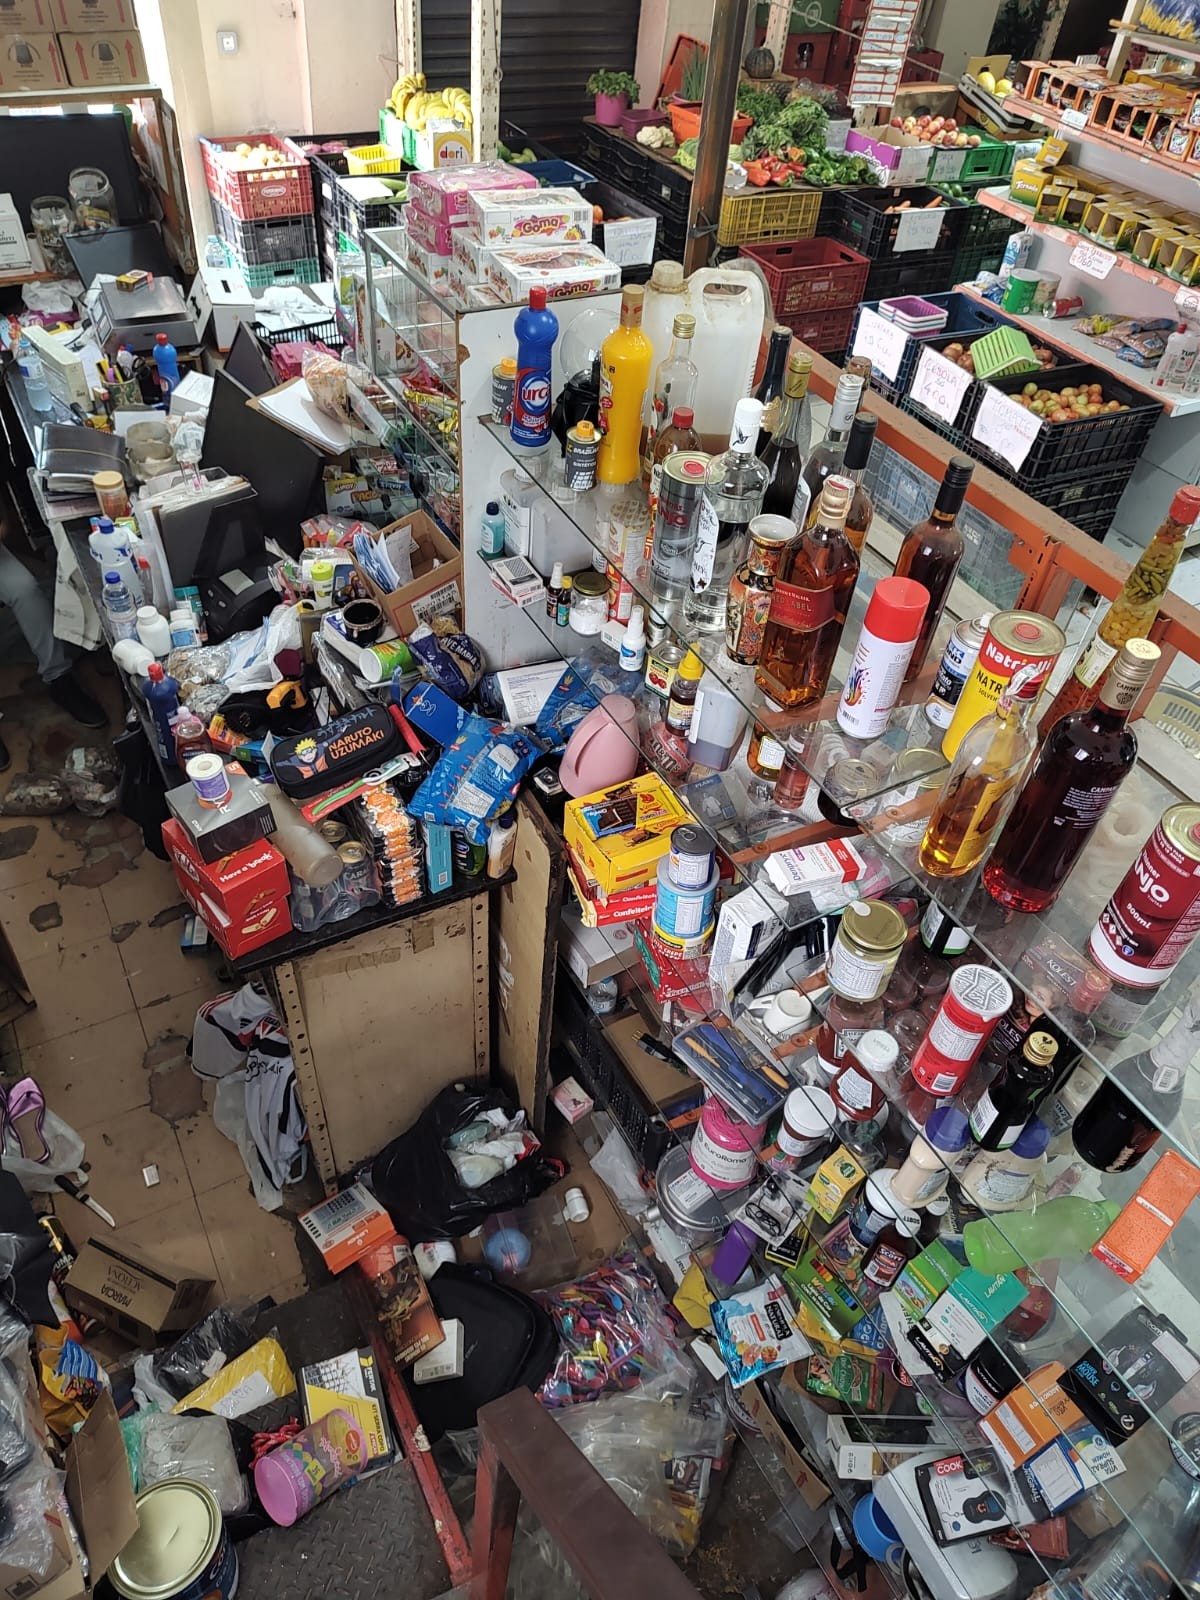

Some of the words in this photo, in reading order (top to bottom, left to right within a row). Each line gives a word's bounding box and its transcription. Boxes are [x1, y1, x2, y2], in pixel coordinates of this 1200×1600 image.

[440, 146, 463, 160] dori
[522, 216, 559, 234] Goma
[328, 727, 373, 752] NARUTO
[330, 731, 384, 760] UZUMAKI
[1126, 902, 1152, 929] 900mL
[100, 1282, 132, 1308] MARCIA
[766, 1305, 784, 1340] NATURAL
[1078, 1363, 1100, 1387] MOUSE
[373, 1415, 381, 1434] SERRA
[936, 1460, 963, 1475] COOK
